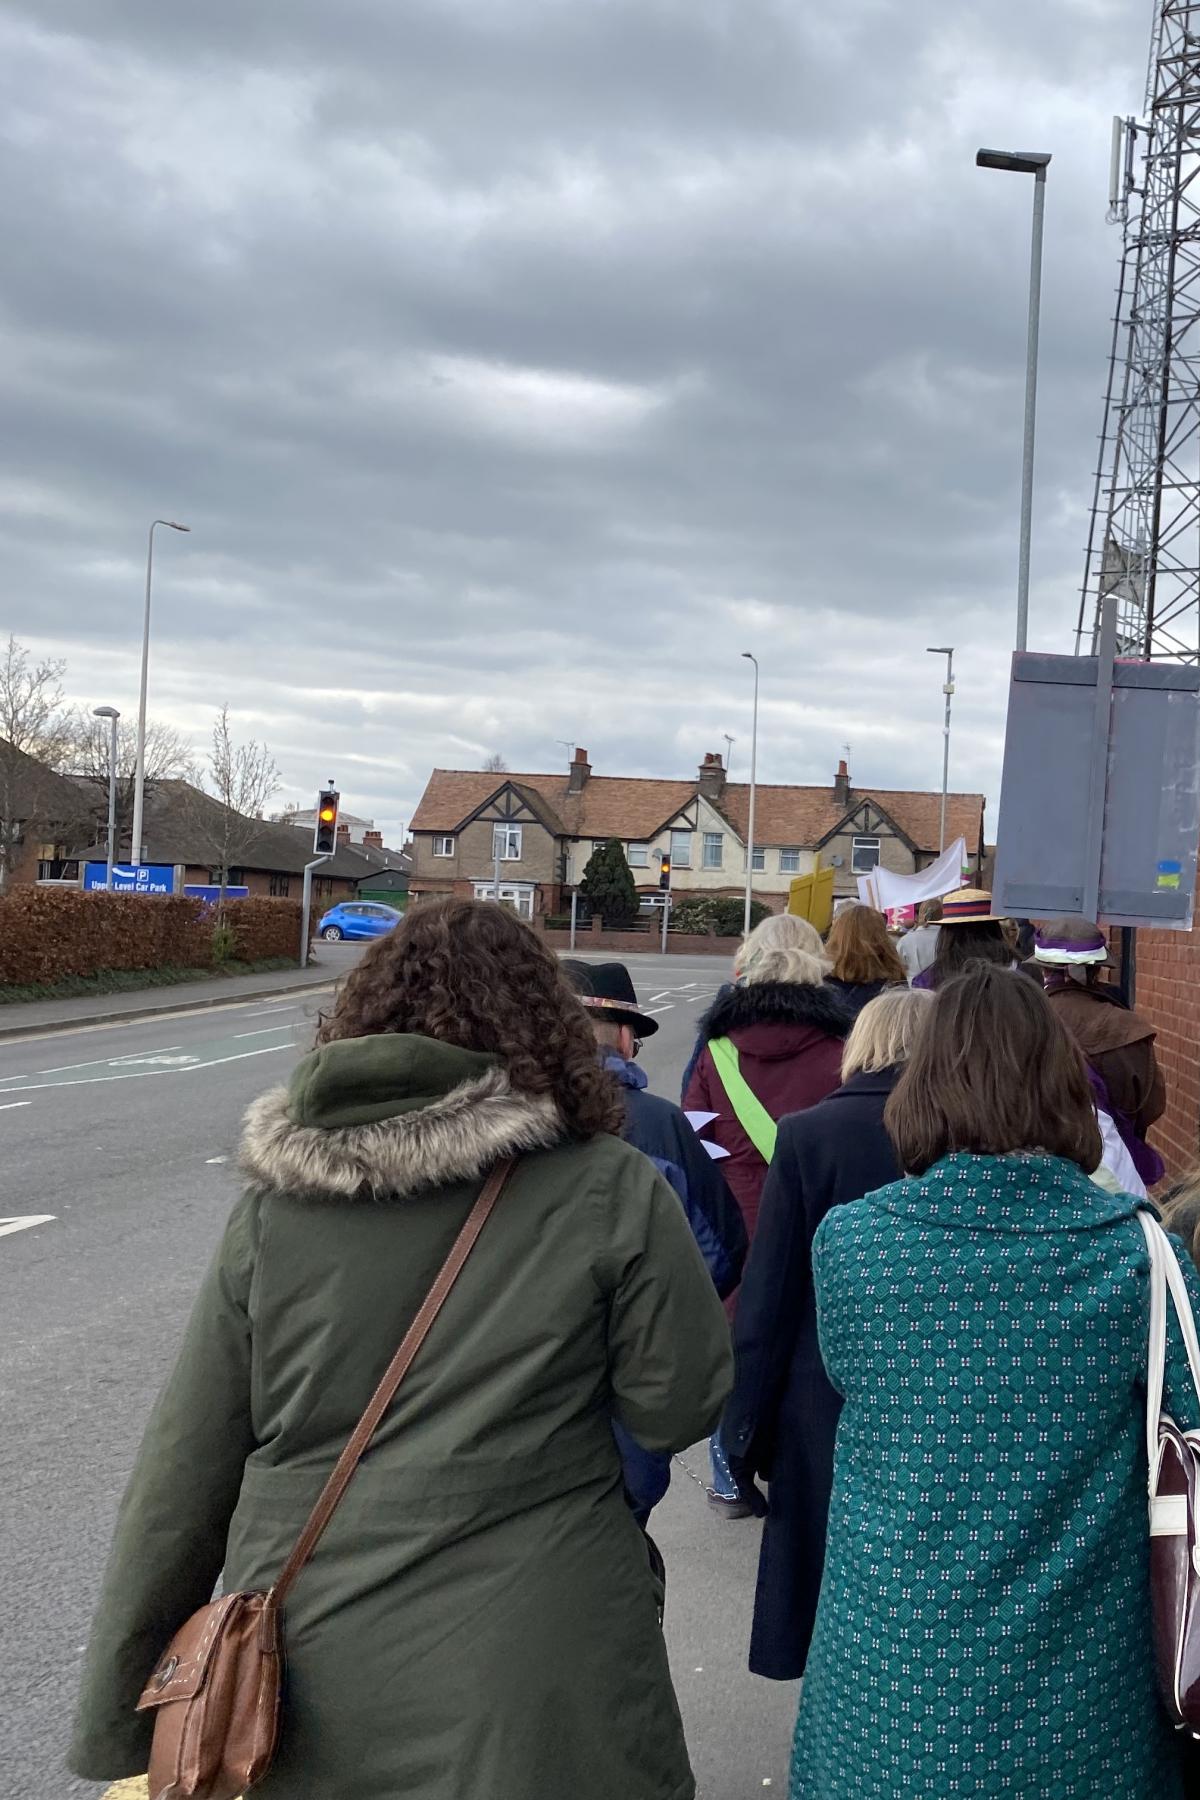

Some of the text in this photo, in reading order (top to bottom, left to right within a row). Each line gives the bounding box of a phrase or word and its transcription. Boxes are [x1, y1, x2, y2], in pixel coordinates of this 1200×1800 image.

[115, 882, 134, 891] Level
[136, 882, 149, 892] Car
[150, 883, 167, 892] Park
